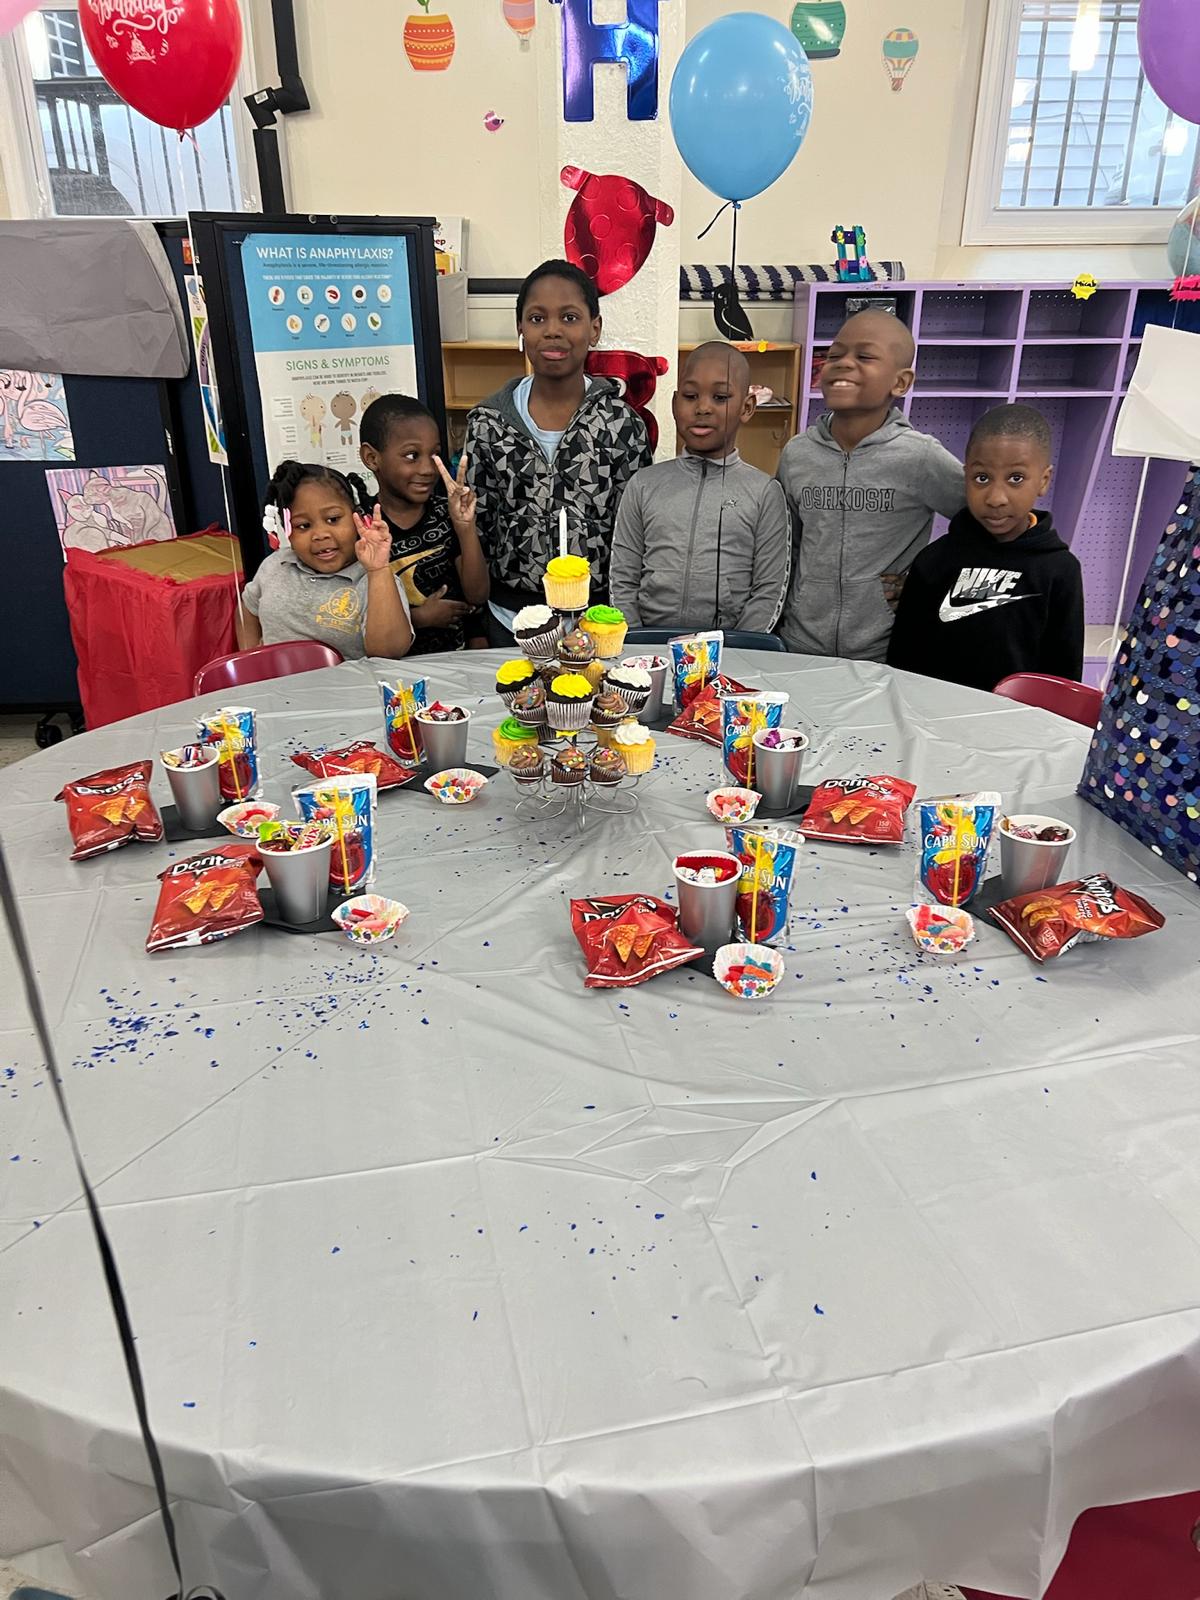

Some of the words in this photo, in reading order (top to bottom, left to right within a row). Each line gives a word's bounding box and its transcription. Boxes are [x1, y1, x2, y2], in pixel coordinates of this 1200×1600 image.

[255, 246, 293, 259] WHAT
[296, 247, 307, 259] IS
[310, 248, 394, 260] ANAPHYLAXIS?
[286, 360, 319, 371] SIGNS
[321, 359, 330, 369] &
[332, 355, 391, 369] SYMPTOMS
[802, 486, 895, 513] OSHKOSH
[951, 567, 1023, 598] NIKE
[824, 779, 893, 795] Doritos
[342, 814, 368, 828] SUN
[924, 833, 956, 849] CAPR
[961, 833, 989, 849] SUN
[760, 869, 788, 890] SUN
